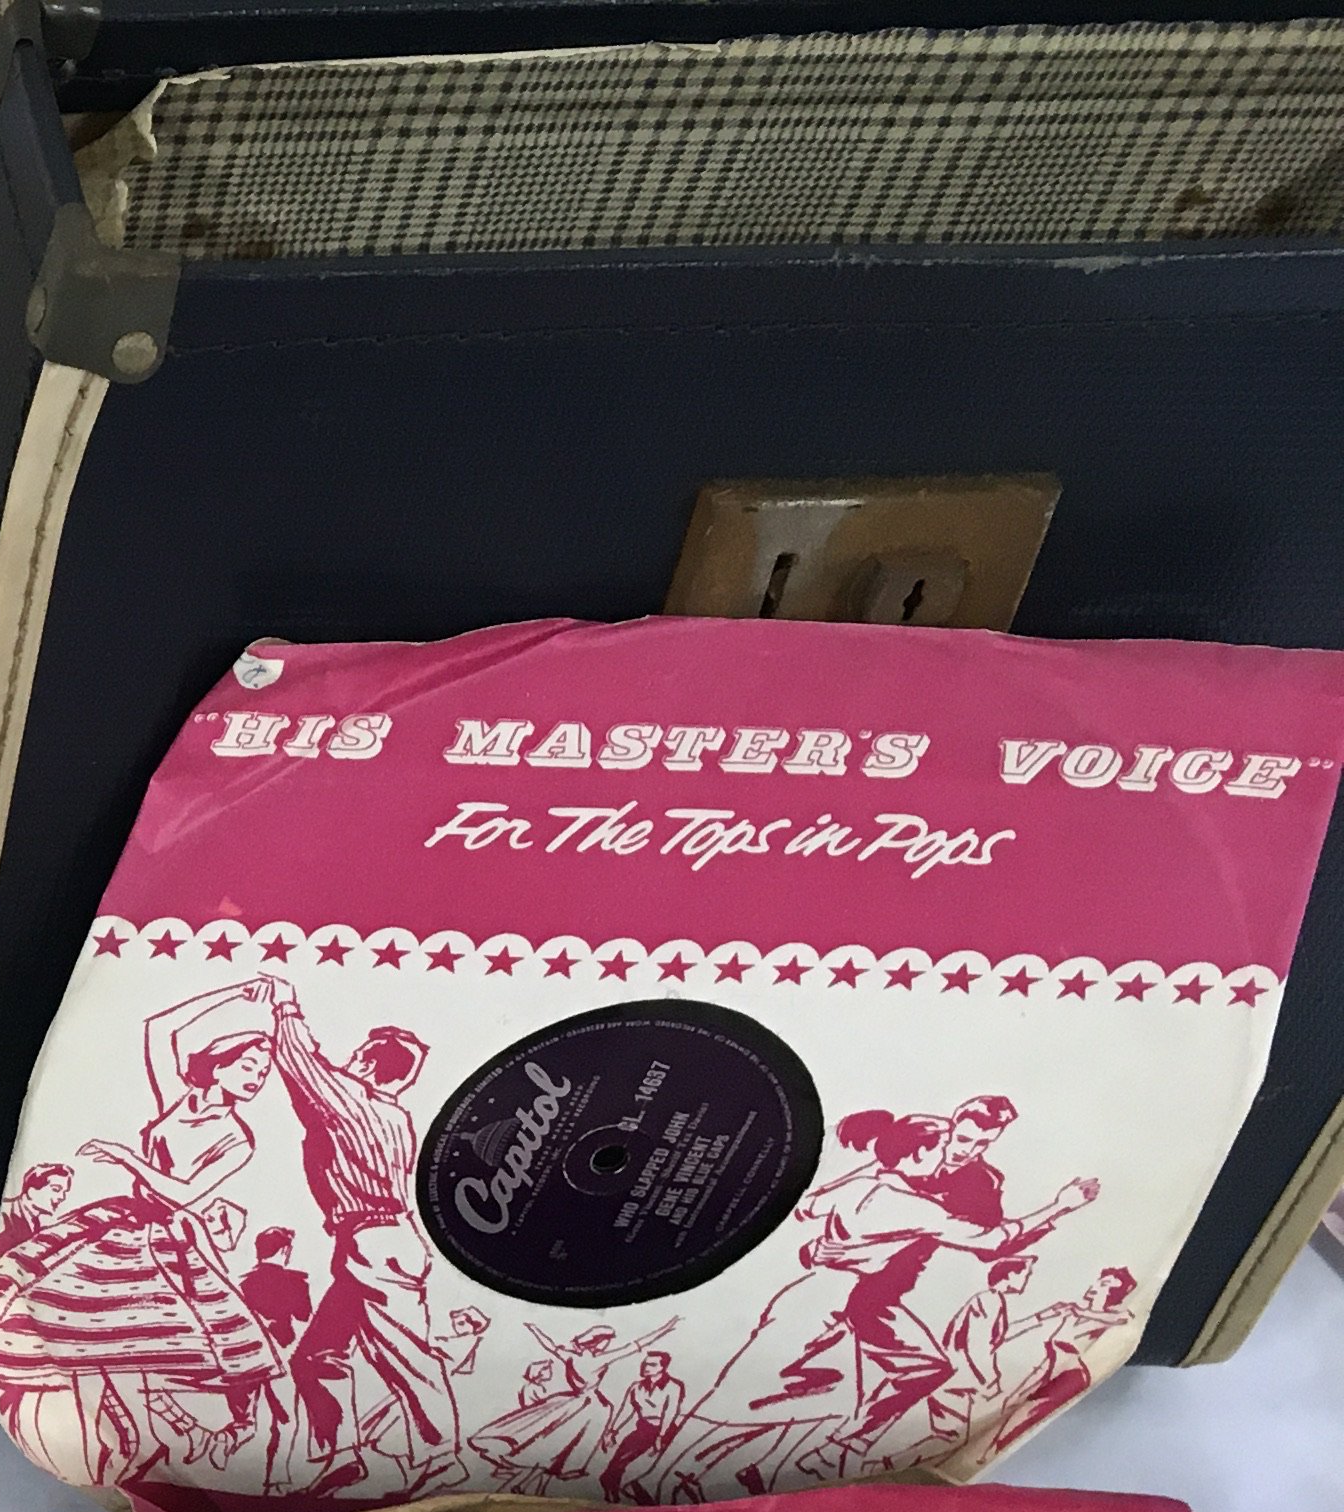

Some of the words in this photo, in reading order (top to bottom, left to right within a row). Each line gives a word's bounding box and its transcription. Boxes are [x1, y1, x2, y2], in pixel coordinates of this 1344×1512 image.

[444, 720, 929, 778] MASTER'S
[426, 800, 534, 851] For
[544, 804, 651, 855] The
[660, 808, 773, 872] Tops
[780, 813, 856, 857] in
[858, 813, 1018, 879] Pops
[618, 1109, 647, 1132] CL.
[634, 1060, 672, 1102] 14637
[454, 1061, 572, 1235] Capitol
[613, 1202, 640, 1228] WHO
[630, 1148, 669, 1203] SLAPPED
[667, 1111, 690, 1144] JOHN
[655, 1185, 683, 1217] GENE
[674, 1135, 712, 1184] VINCENT
